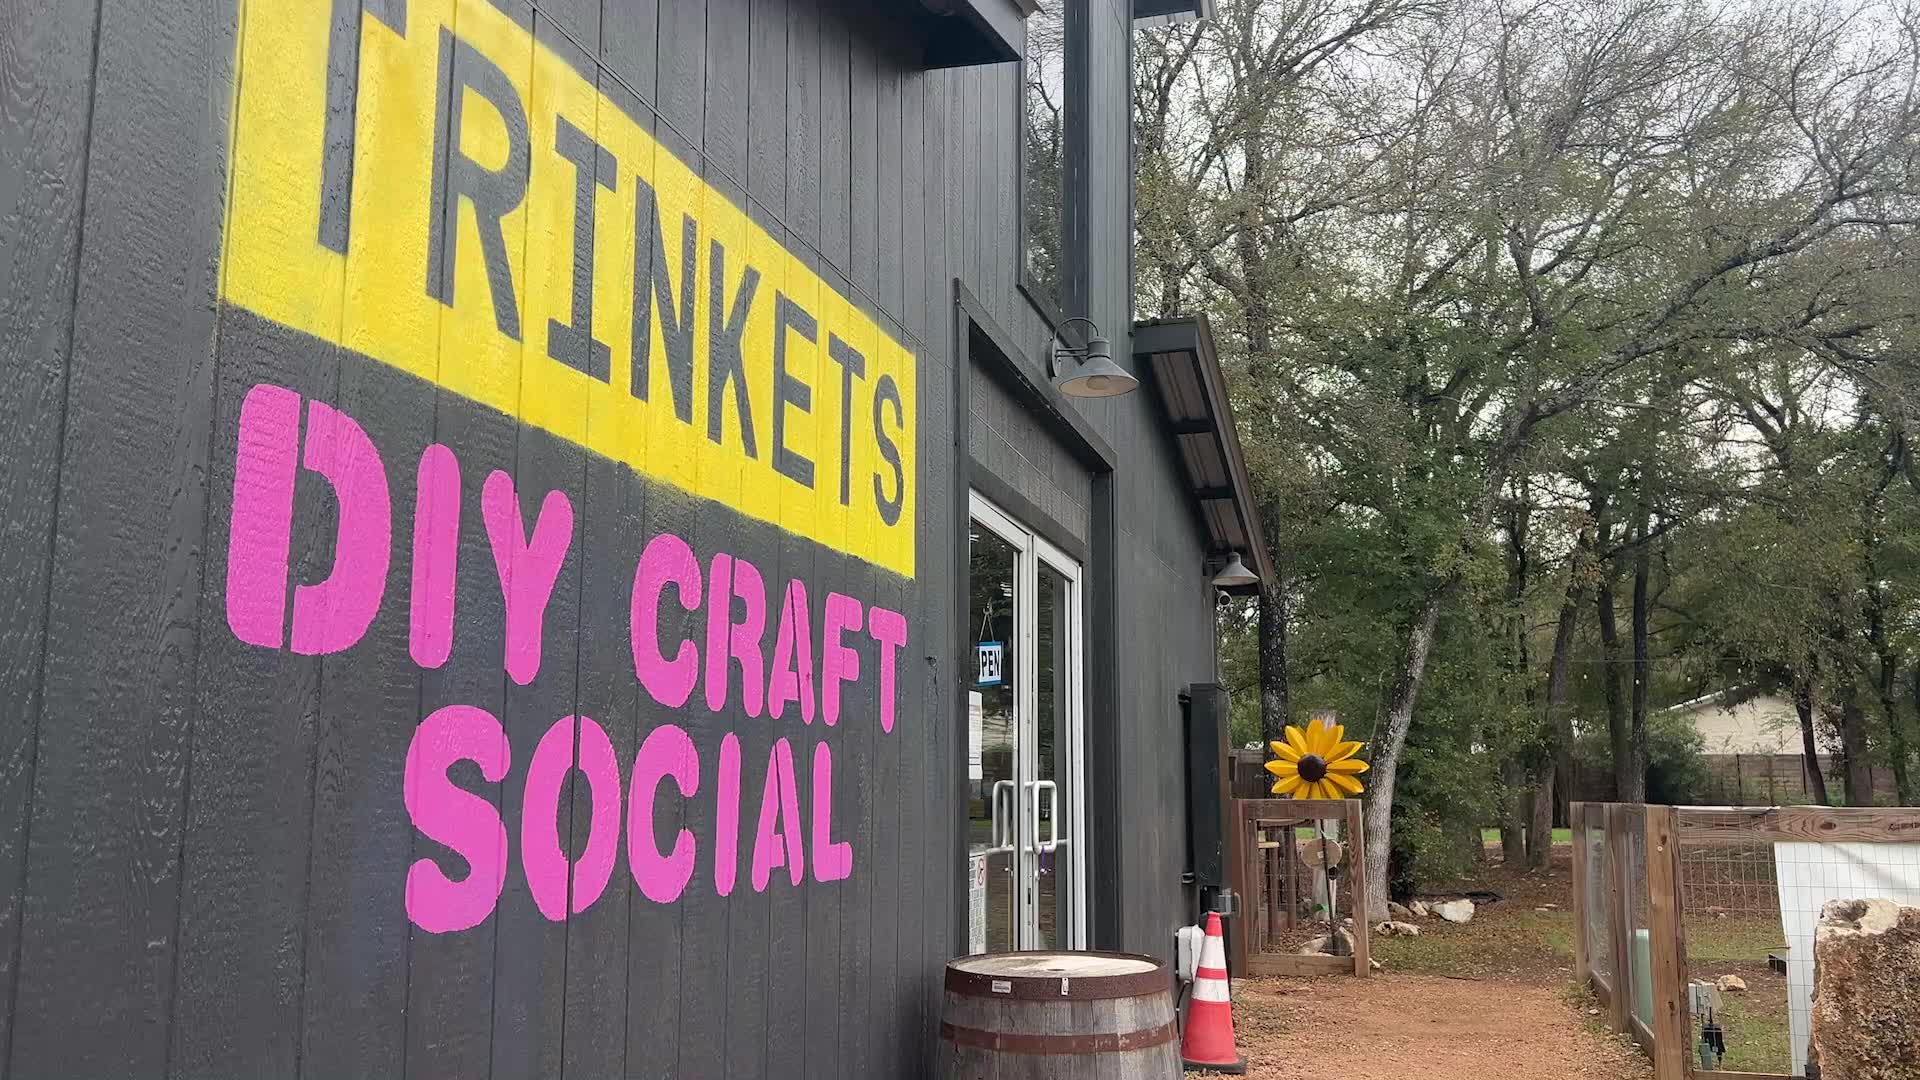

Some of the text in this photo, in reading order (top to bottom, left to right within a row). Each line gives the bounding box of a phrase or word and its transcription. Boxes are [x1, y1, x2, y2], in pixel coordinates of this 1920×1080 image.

[225, 384, 908, 733] DIY CRAFT
[977, 650, 1000, 677] PEN
[403, 705, 853, 934] SOCIAL
